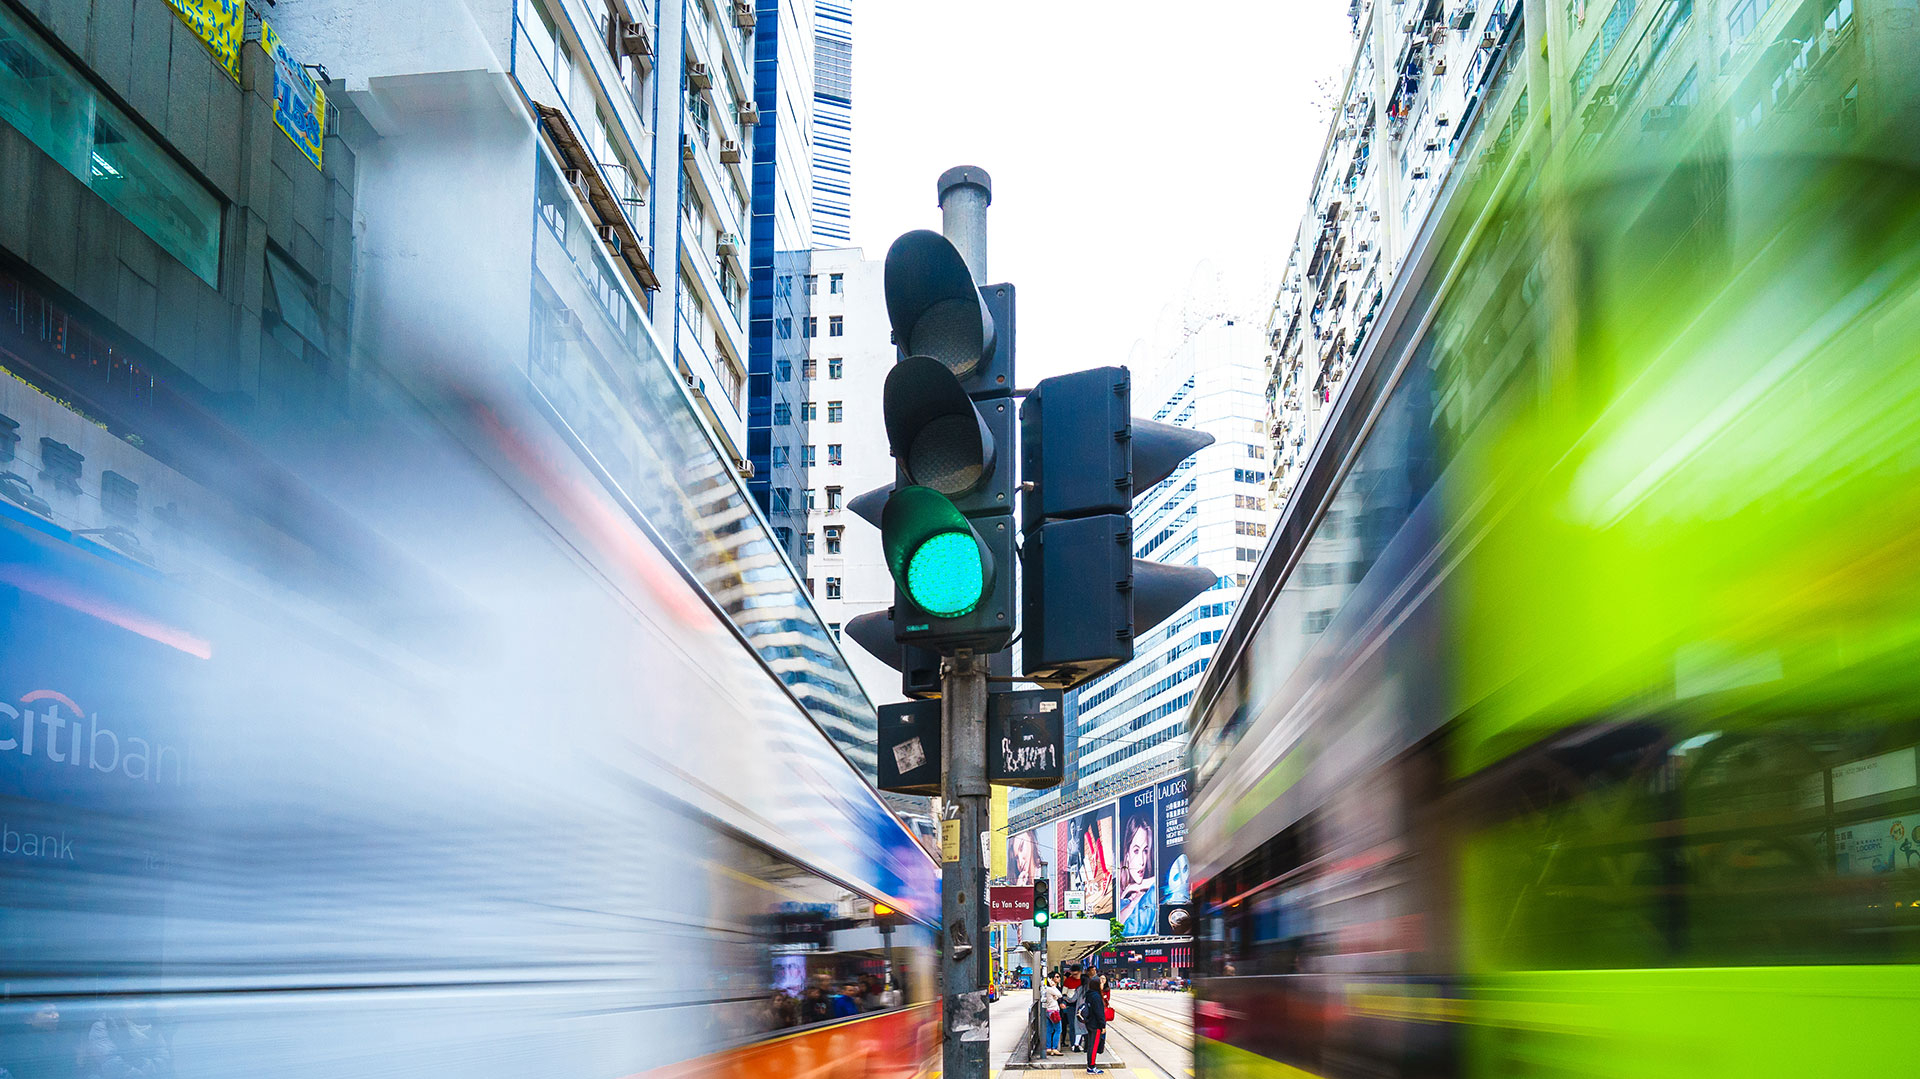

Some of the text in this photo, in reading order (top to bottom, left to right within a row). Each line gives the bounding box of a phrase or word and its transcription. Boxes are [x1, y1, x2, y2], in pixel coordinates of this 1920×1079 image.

[1134, 779, 1187, 808] ESTÉE LAUDER
[992, 900, 1030, 910] Eu Yan Sang
